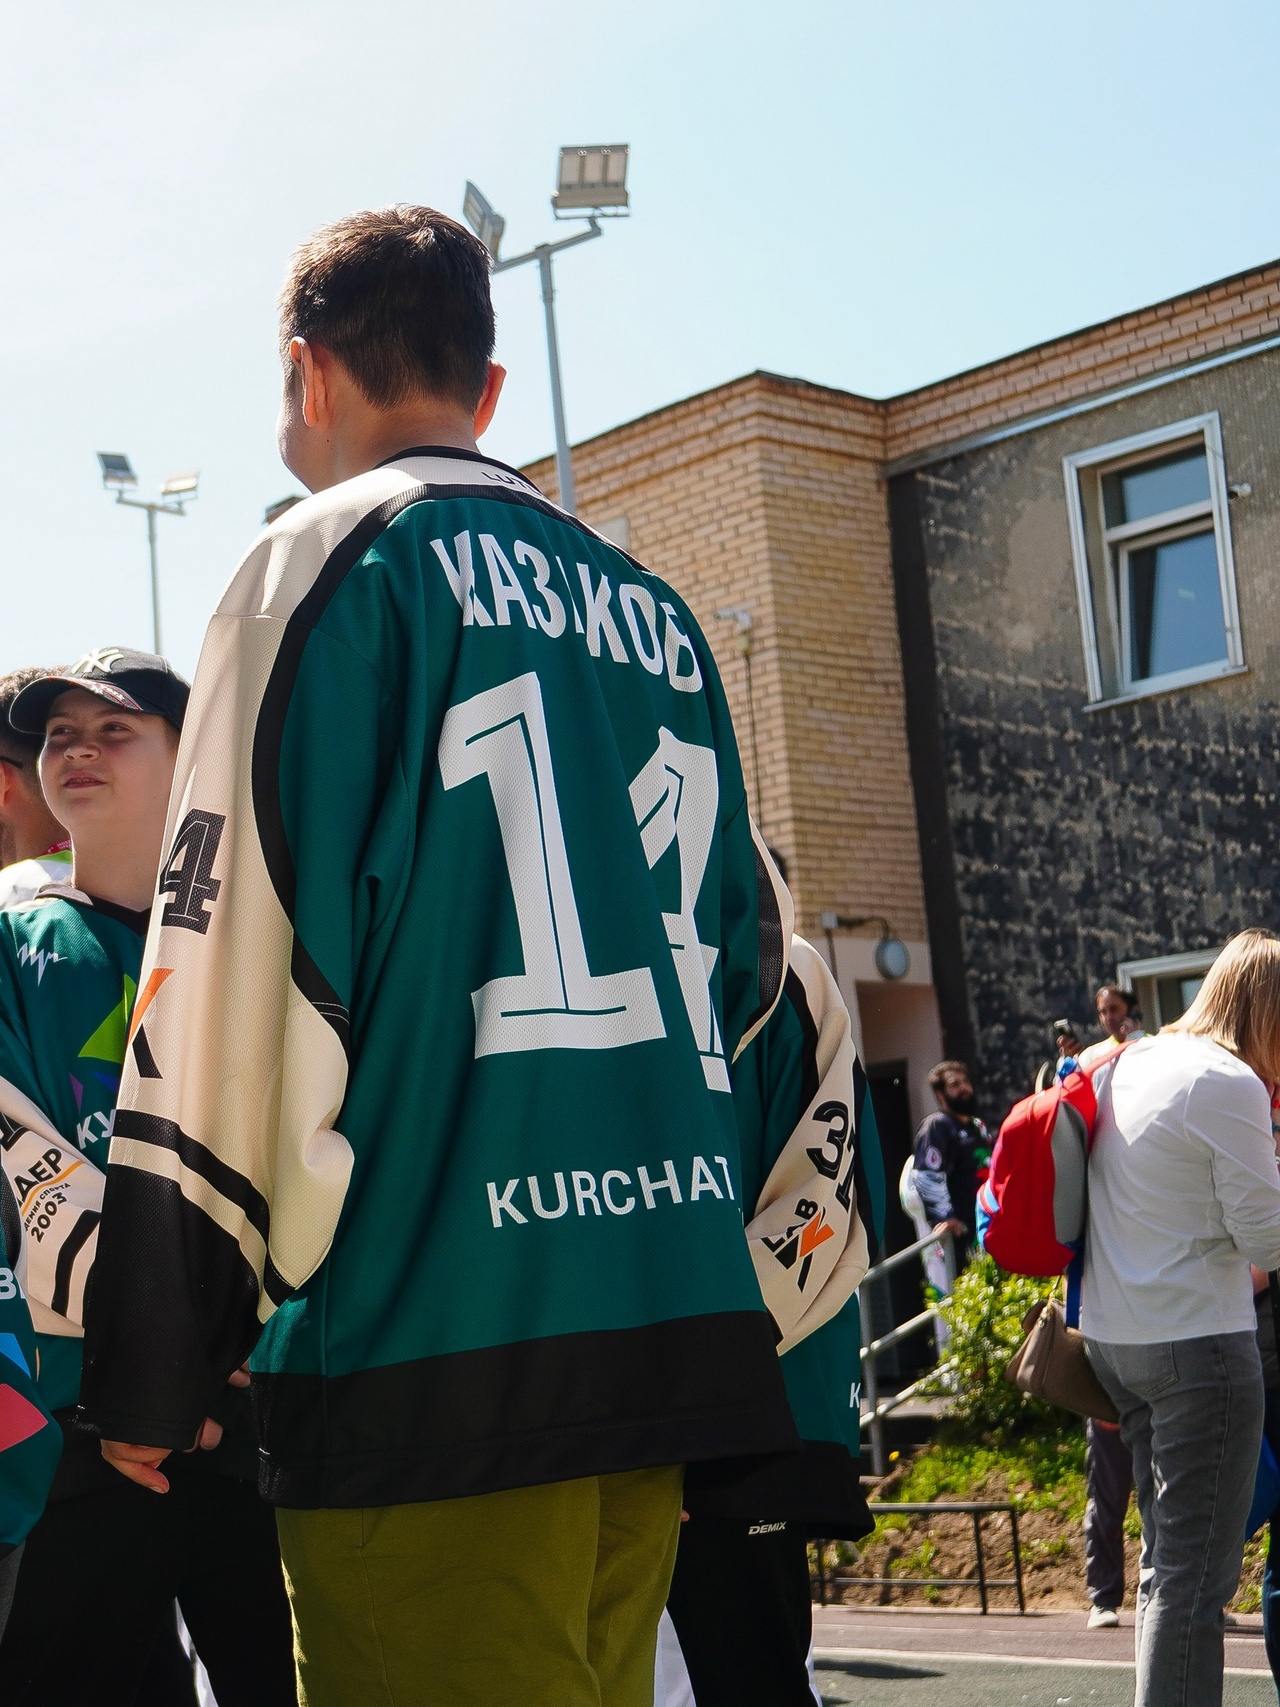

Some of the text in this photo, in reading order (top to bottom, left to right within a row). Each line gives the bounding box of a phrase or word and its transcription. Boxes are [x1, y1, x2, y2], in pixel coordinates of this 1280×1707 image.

[429, 530, 703, 693] КАЗКОВ
[14, 1148, 62, 1206] ДЕР
[24, 1200, 42, 1232] ДЕМИЯ
[31, 1192, 68, 1244] 2003
[748, 1520, 787, 1535] DEMIX
